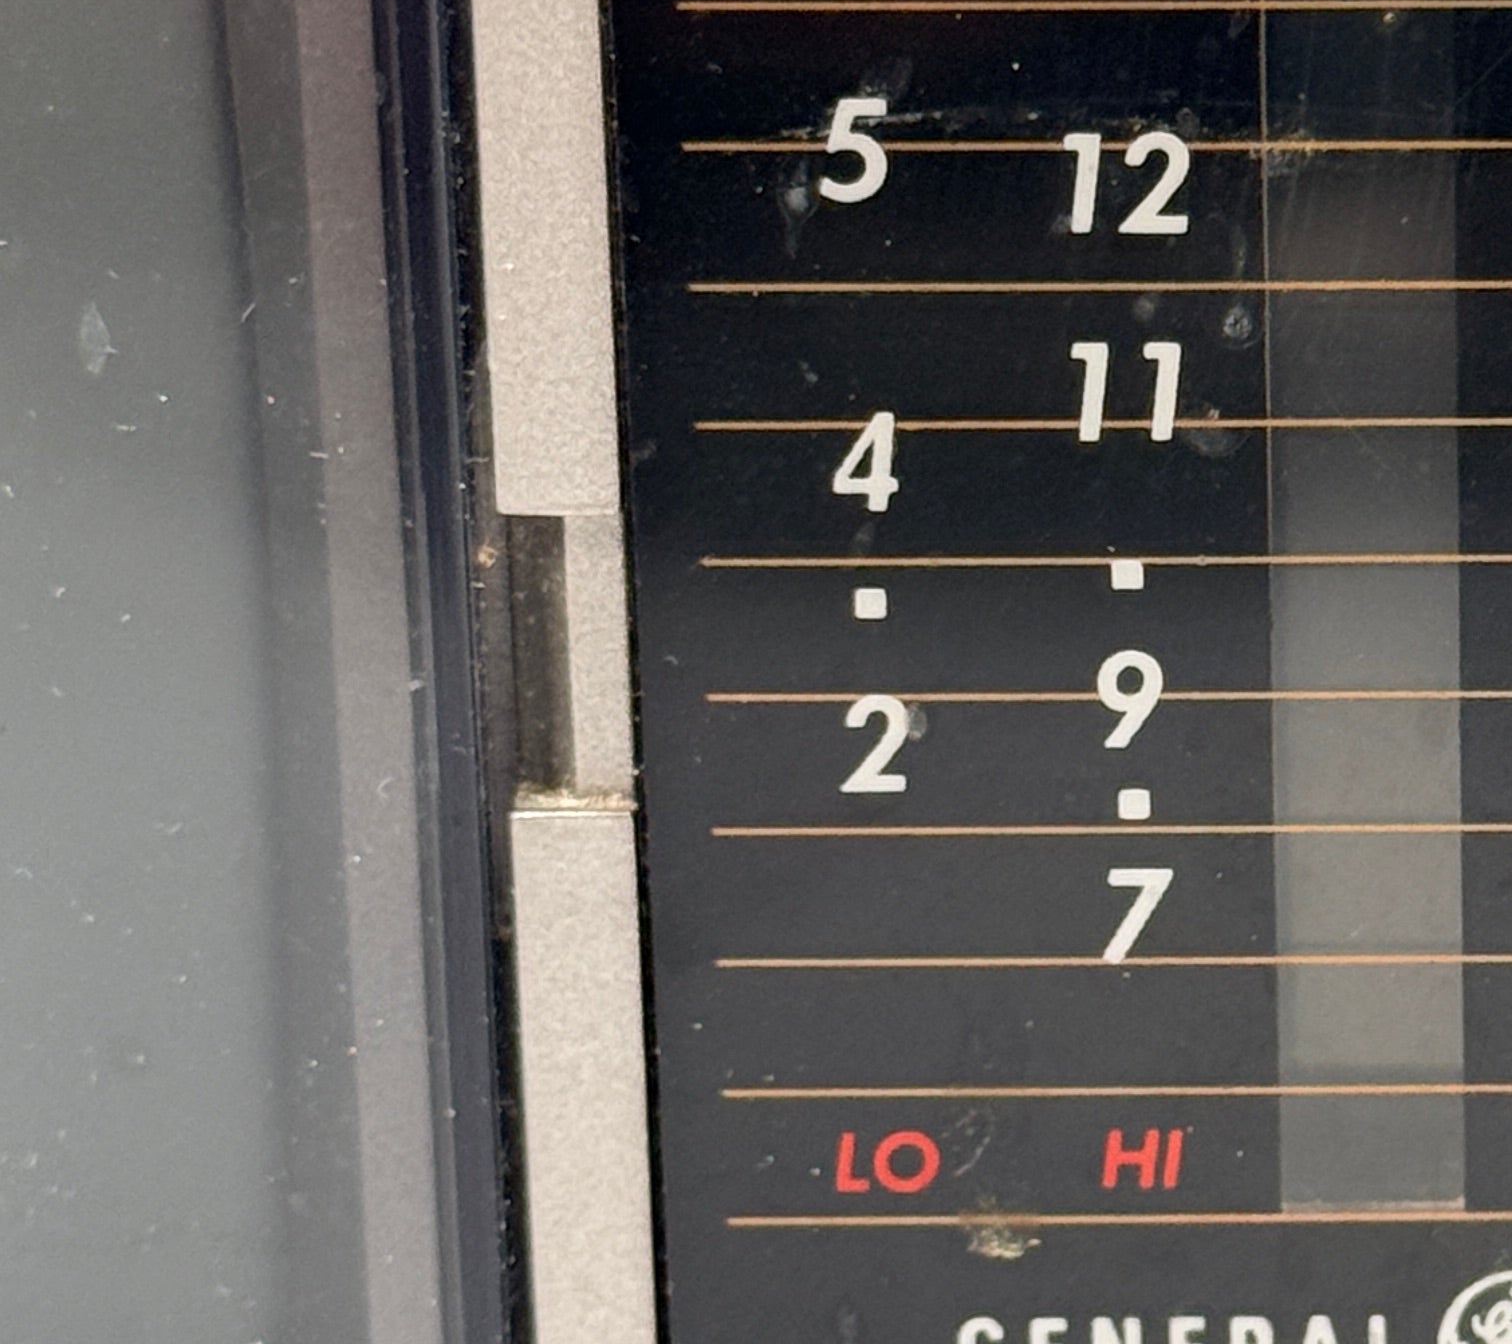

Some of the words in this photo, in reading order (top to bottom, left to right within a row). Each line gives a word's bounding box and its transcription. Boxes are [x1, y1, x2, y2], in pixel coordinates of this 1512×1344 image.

[819, 97, 887, 203] 5
[1062, 131, 1190, 234] 12
[1071, 341, 1182, 442] 11
[833, 411, 899, 512] 4
[840, 693, 911, 793] 2
[1096, 649, 1165, 749] 9
[1088, 868, 1174, 965] 7
[835, 1130, 940, 1193] LO
[1102, 1128, 1183, 1189] HI
